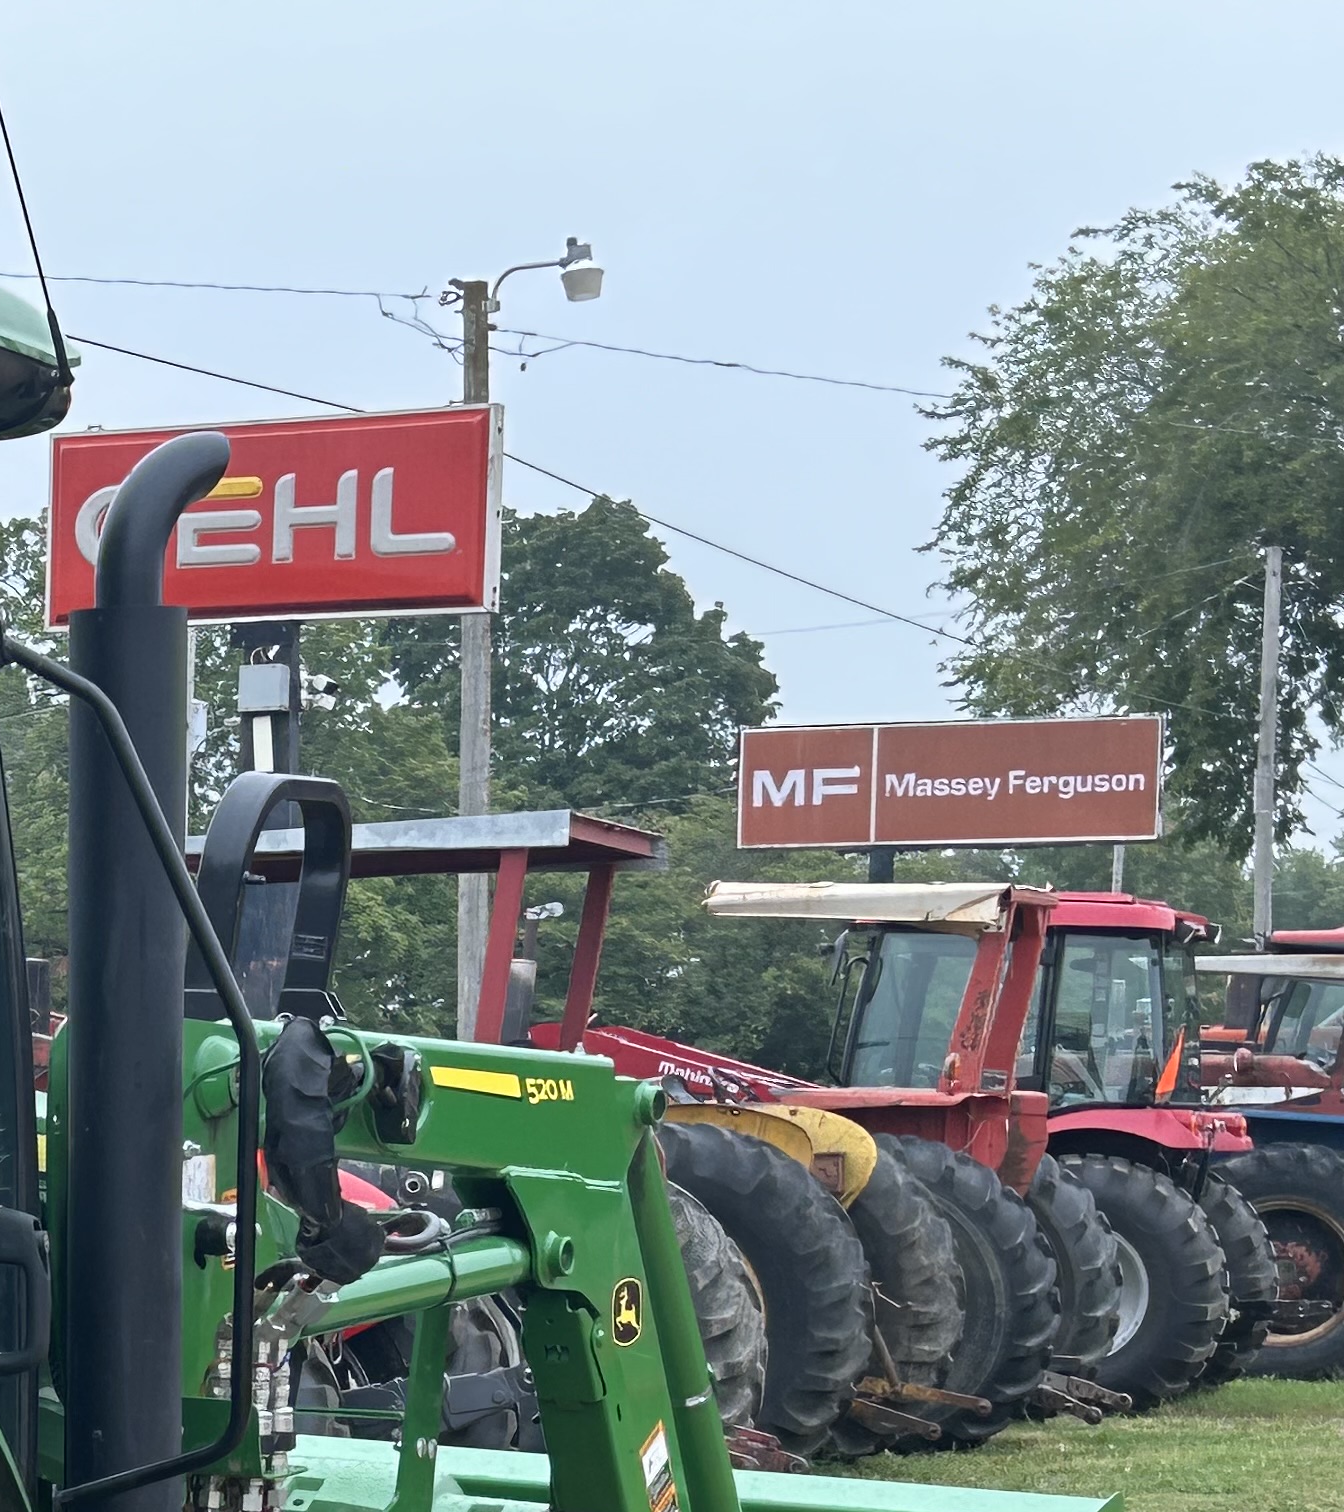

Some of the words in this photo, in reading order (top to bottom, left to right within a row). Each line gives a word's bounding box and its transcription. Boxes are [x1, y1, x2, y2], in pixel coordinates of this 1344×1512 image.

[752, 766, 861, 807] MF
[884, 771, 1001, 801] Massey
[1008, 769, 1145, 800] Ferguson
[658, 1060, 740, 1094] Mahina
